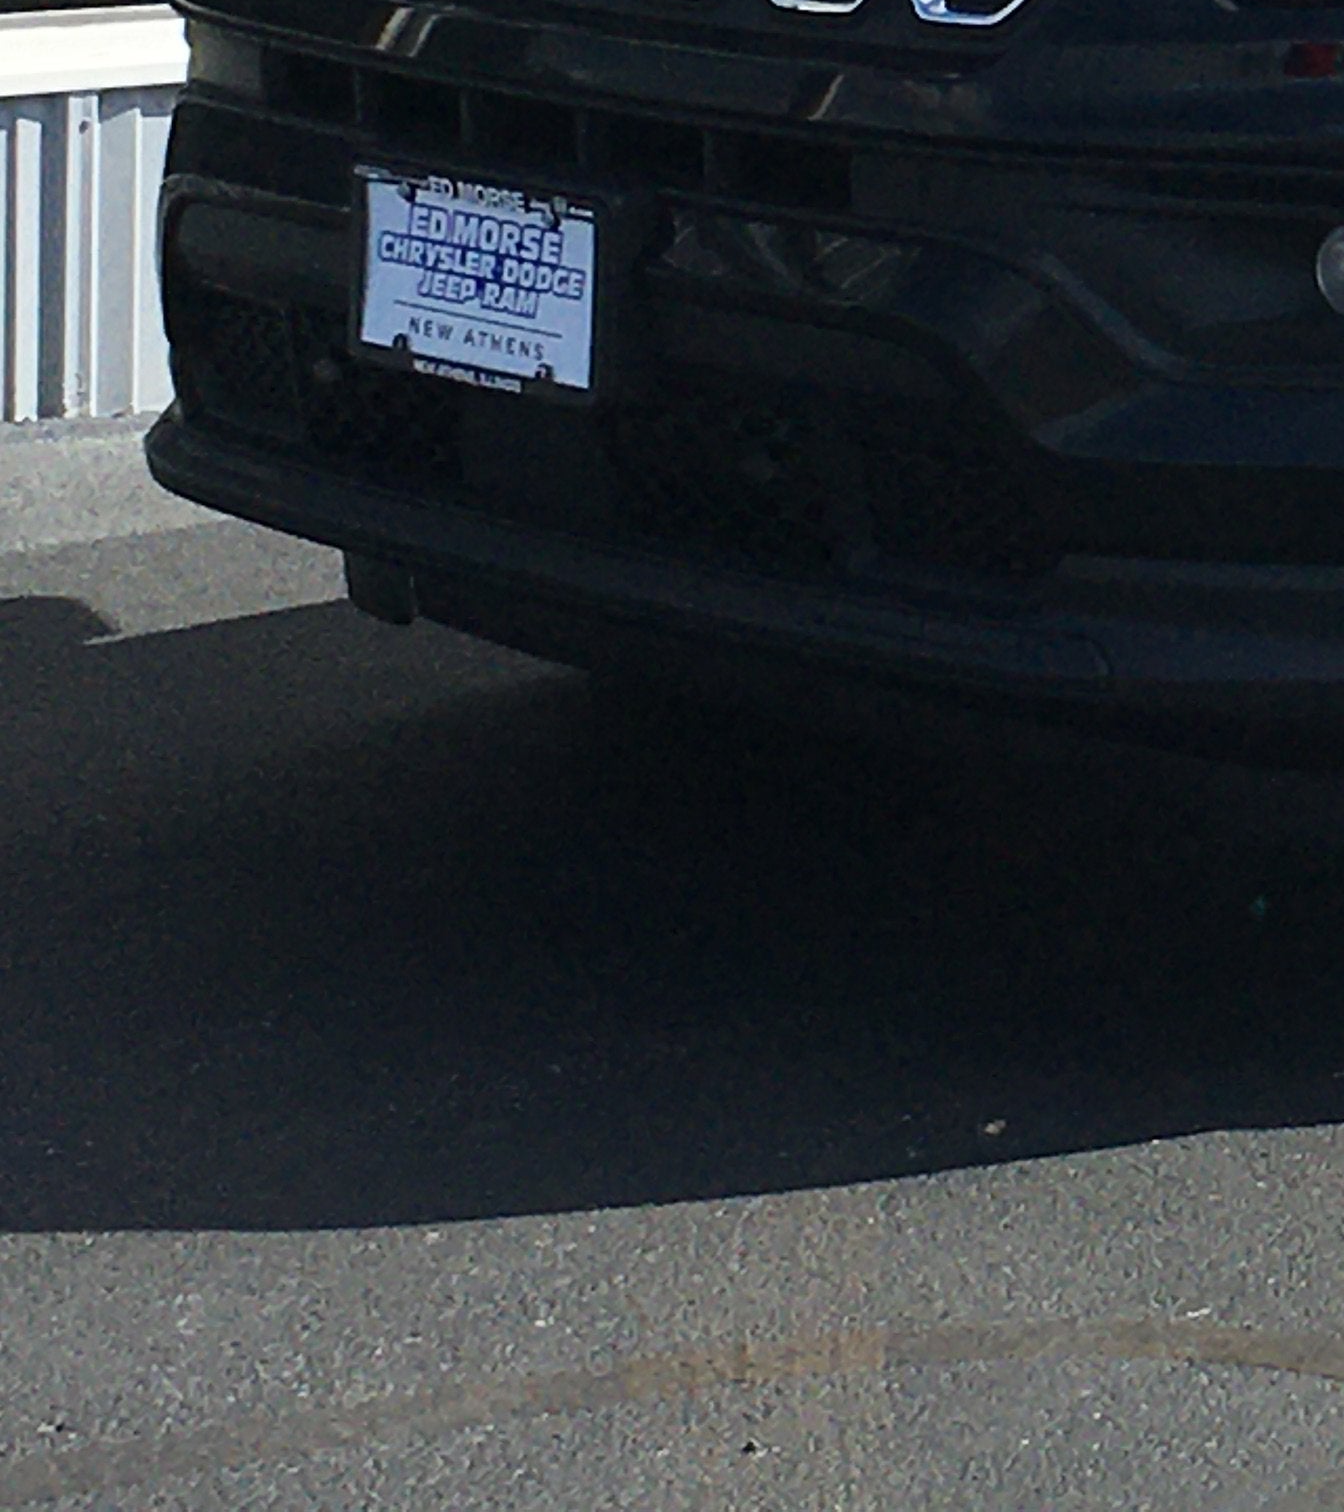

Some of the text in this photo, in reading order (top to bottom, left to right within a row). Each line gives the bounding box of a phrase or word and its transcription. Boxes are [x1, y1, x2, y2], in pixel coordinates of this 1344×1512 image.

[409, 204, 563, 264] ED MORSE
[380, 232, 585, 301] CHRYSLER DODGE
[419, 270, 540, 318] JEEP RAM
[408, 316, 545, 362] NEW ATHENS
